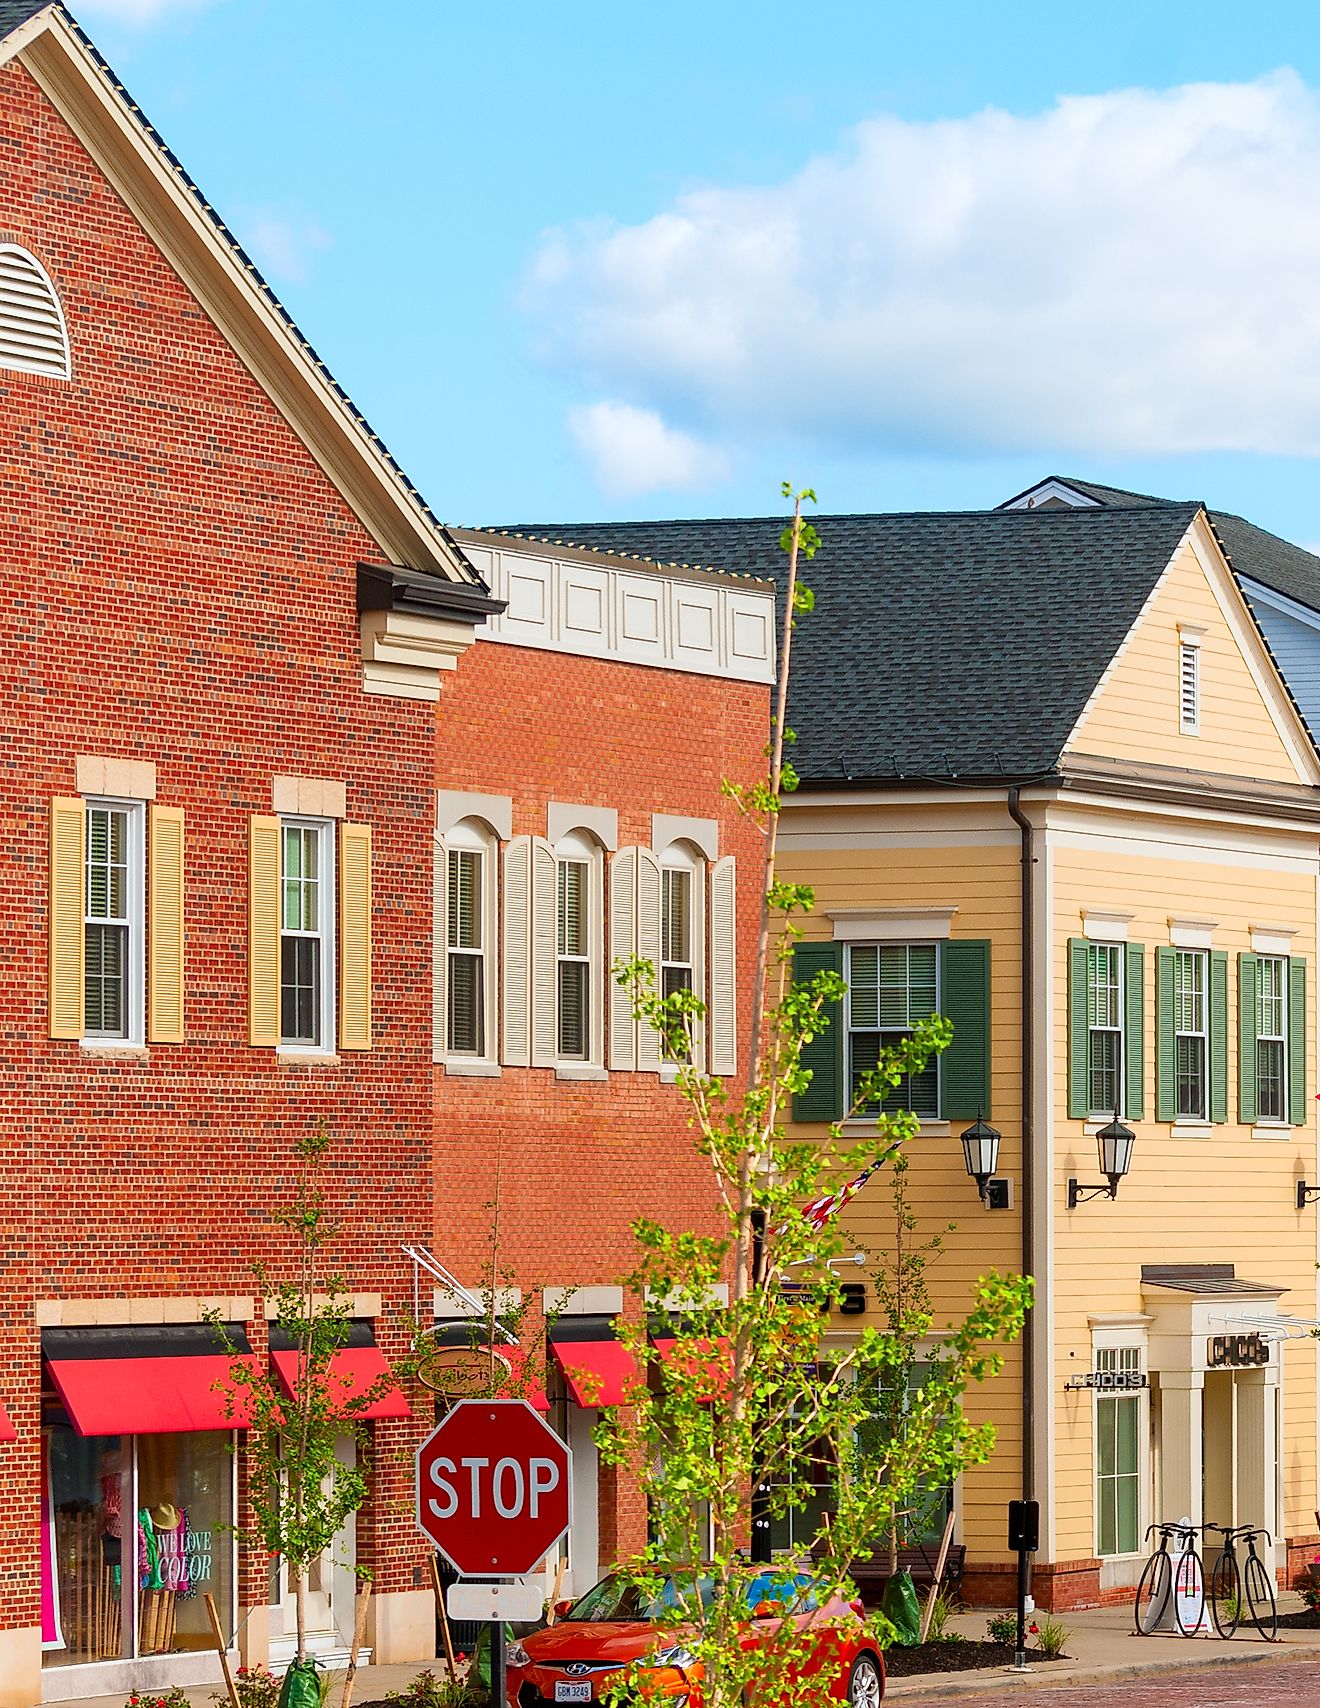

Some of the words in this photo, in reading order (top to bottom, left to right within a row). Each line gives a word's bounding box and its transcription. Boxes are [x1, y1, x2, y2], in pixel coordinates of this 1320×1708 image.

[1071, 1373, 1145, 1388] CHICO'S
[428, 1456, 560, 1519] STOP
[156, 1533, 178, 1553] WE
[179, 1530, 212, 1552] LOVE
[157, 1554, 212, 1584] COLOR
[571, 1686, 589, 1697] 3249
